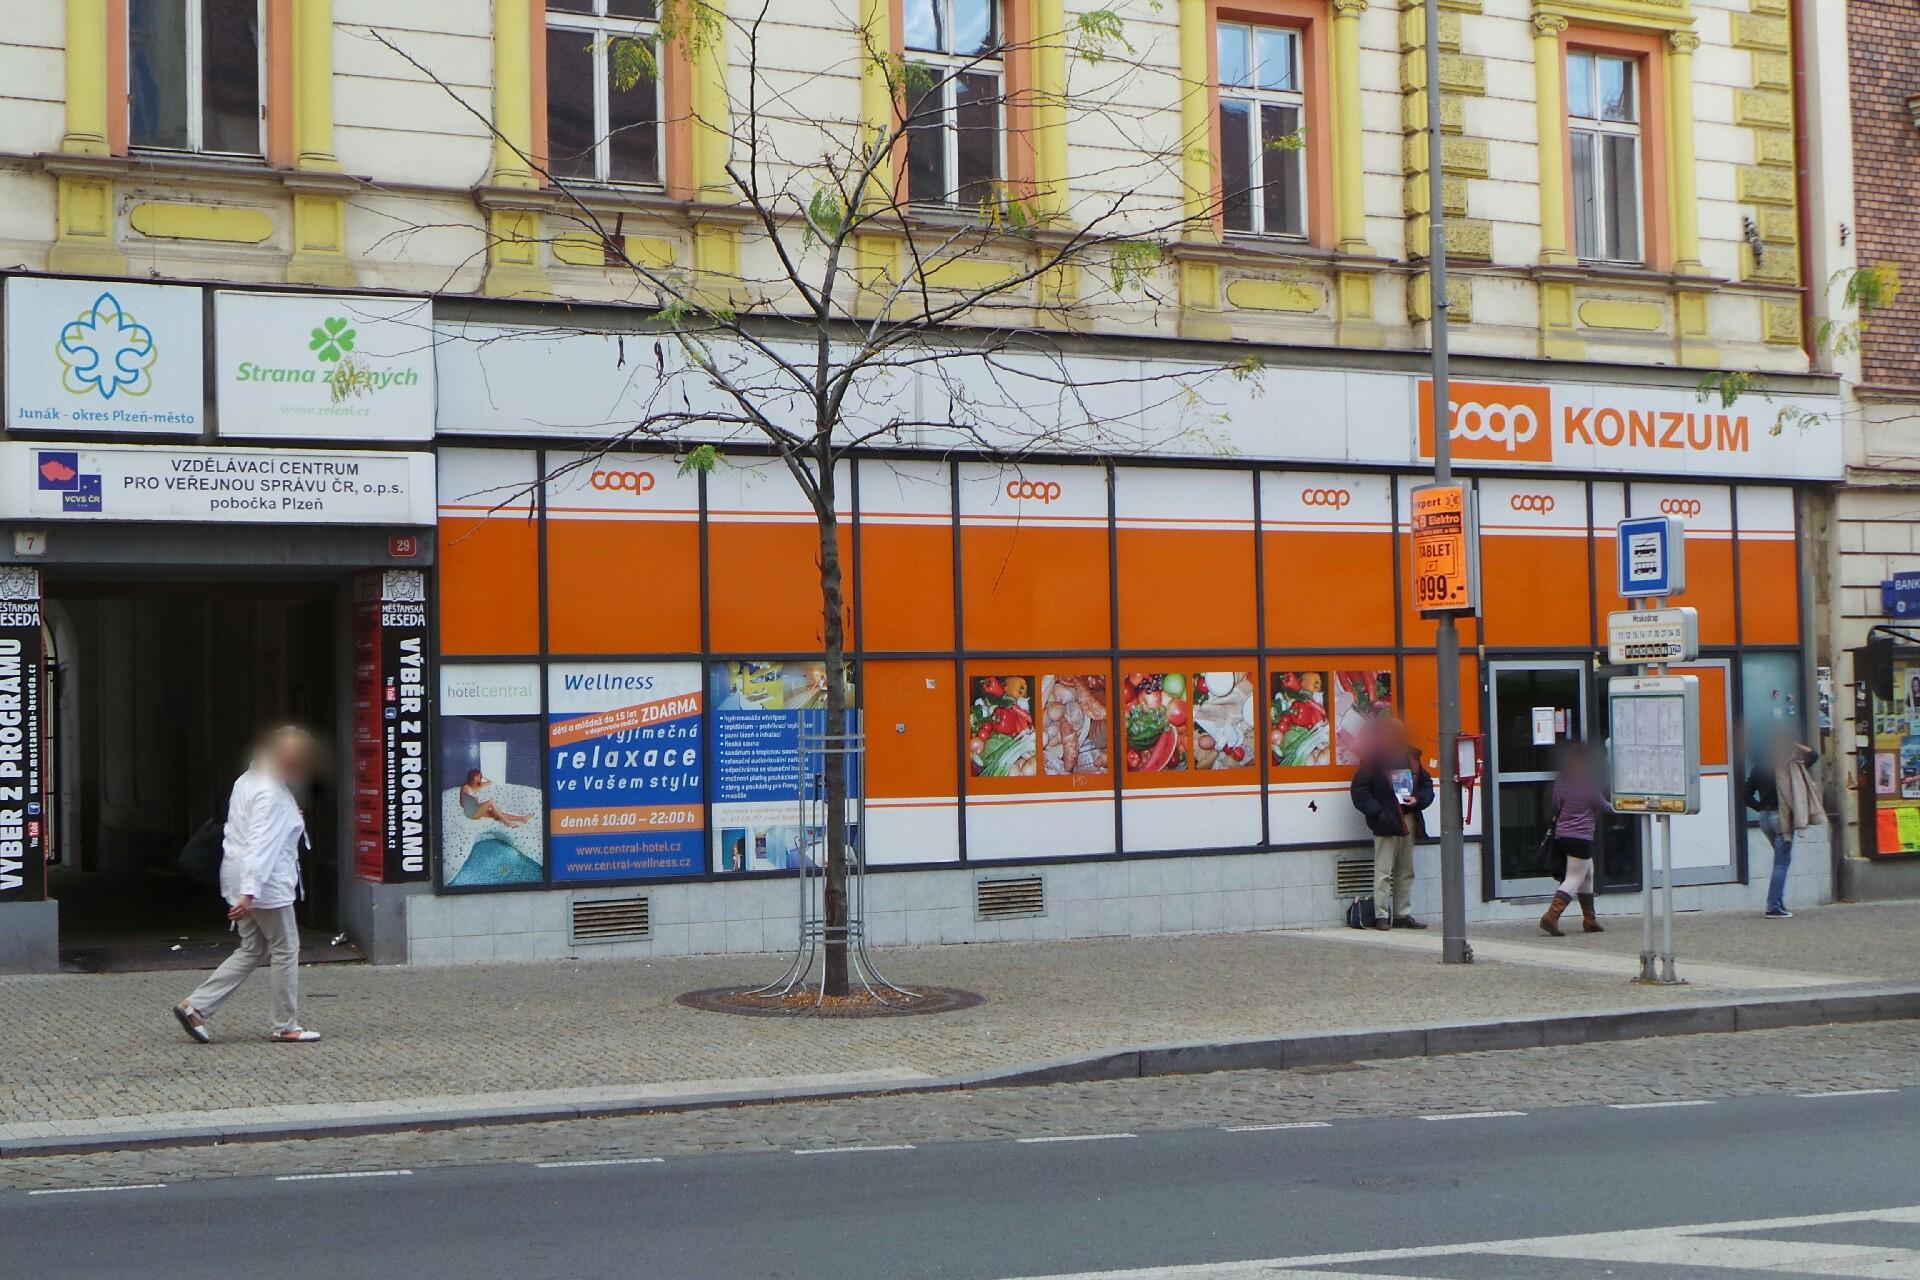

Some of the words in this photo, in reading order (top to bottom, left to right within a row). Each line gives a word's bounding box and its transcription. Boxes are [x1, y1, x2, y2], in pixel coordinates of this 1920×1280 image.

[236, 362, 315, 383] Strana
[321, 367, 419, 389] zených
[19, 407, 60, 420] Junák
[72, 409, 109, 422] okres
[112, 409, 195, 424] Plzeň-město
[1563, 405, 1750, 453] KONZUM
[171, 457, 275, 474] VZDĚLÁVACÍ
[280, 462, 359, 475] CENTRUM
[124, 476, 160, 489] PRO
[165, 475, 255, 491] VEŘEJNOU
[260, 478, 326, 492] SPRÁVU
[332, 478, 359, 495] ČR,
[363, 484, 404, 496] o.p.s.
[590, 470, 655, 495] coop
[64, 495, 87, 503] VCVS
[88, 494, 101, 503] ČR
[1006, 480, 1061, 504] coop
[1302, 488, 1351, 511] coop
[210, 496, 277, 511] pobočka
[282, 498, 323, 510] Plzeň
[1511, 493, 1555, 516] coop
[1660, 498, 1702, 519] coop
[27, 537, 34, 551] 7
[396, 539, 410, 552] 29
[1419, 543, 1451, 557] TABLET
[382, 613, 426, 627] BESEDA
[400, 637, 424, 713] VÝBĚR
[564, 673, 654, 691] Wellness
[574, 717, 603, 731] mládež
[604, 715, 614, 723] do
[616, 712, 625, 721] 15
[641, 697, 698, 723] ZDARMA
[401, 720, 422, 734] Z
[556, 745, 697, 769] relaxace
[556, 778, 577, 791] ve
[584, 773, 644, 790] Vašem
[649, 772, 699, 792] stylu
[0, 786, 23, 801] Z
[401, 741, 424, 872] PROGRAMU
[560, 814, 599, 828] denně
[602, 813, 637, 827] 10:00
[650, 811, 684, 824] 22:00
[687, 811, 695, 823] h
[576, 841, 682, 856] www.central-hotel.cz
[566, 858, 692, 873] www.central-wellness.cz
